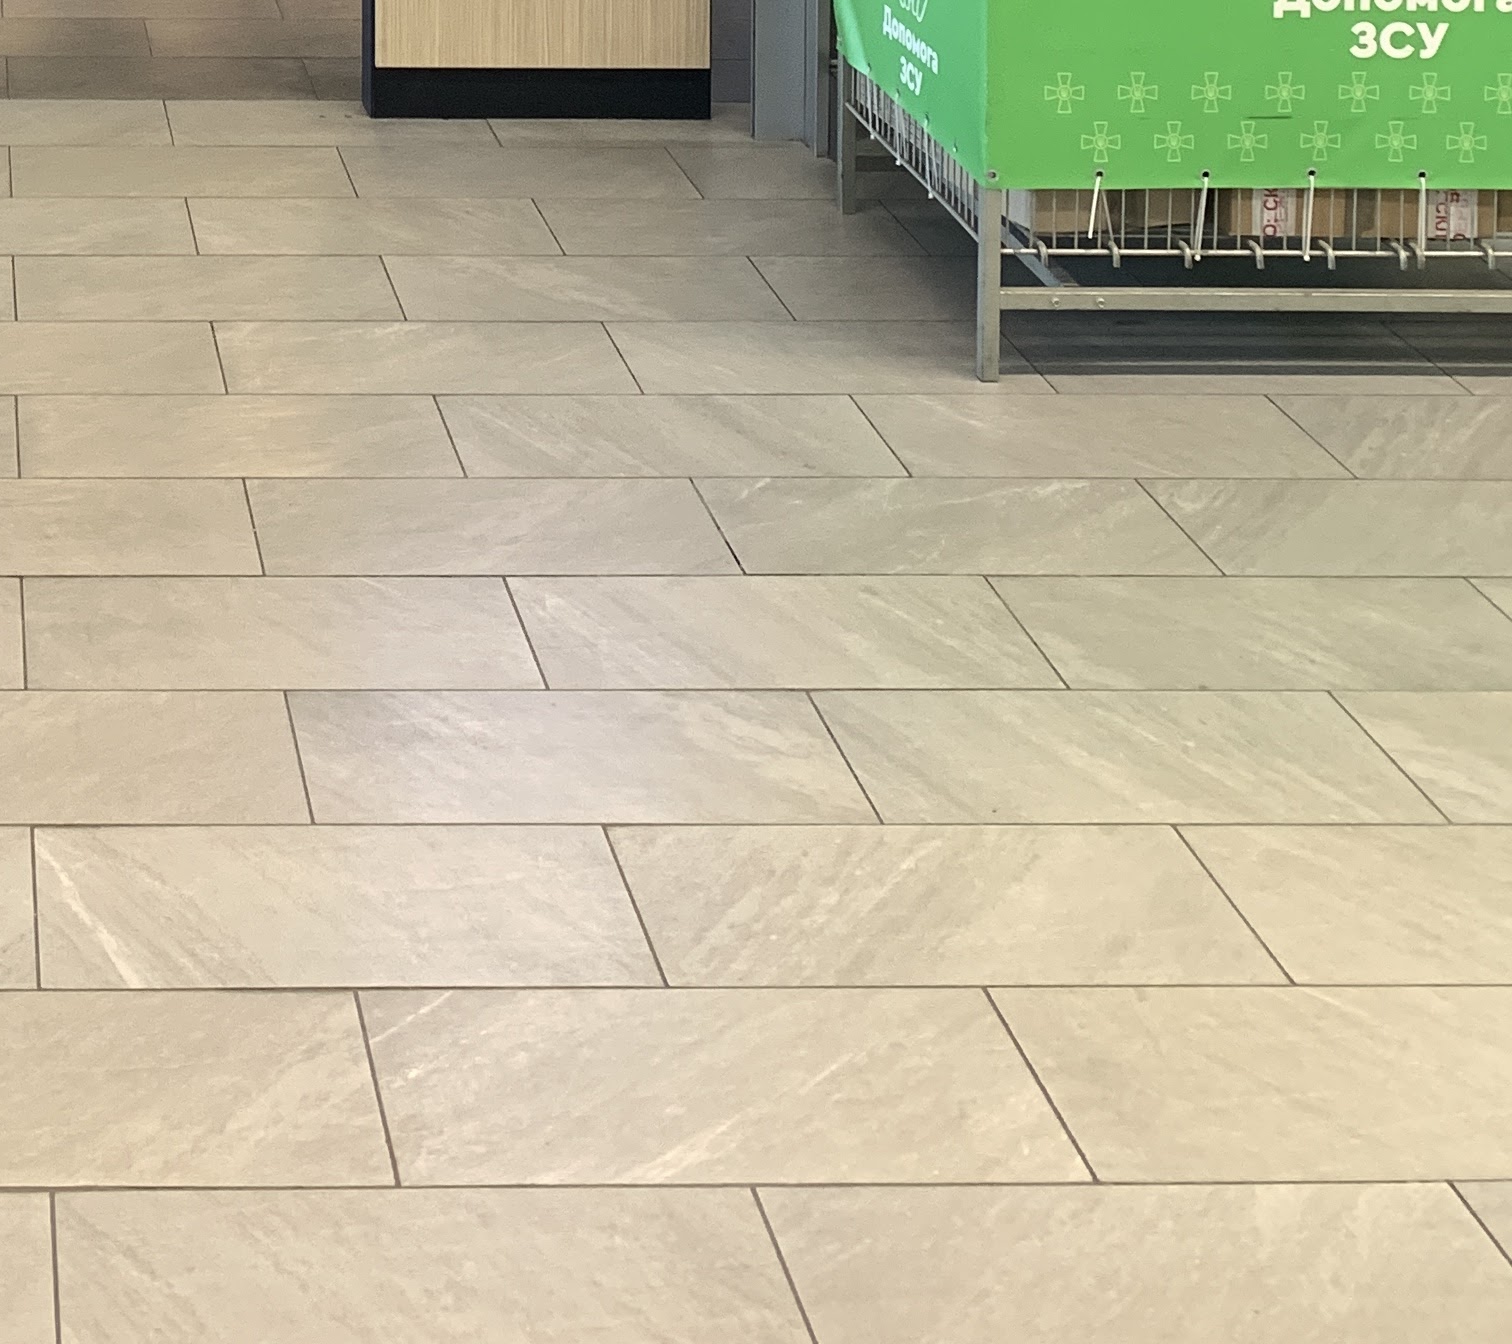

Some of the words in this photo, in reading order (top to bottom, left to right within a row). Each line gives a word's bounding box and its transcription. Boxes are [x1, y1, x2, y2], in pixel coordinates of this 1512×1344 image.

[882, 4, 939, 75] Допомога
[1349, 21, 1450, 59] ЗСУ
[899, 55, 923, 96] ЗСУ
